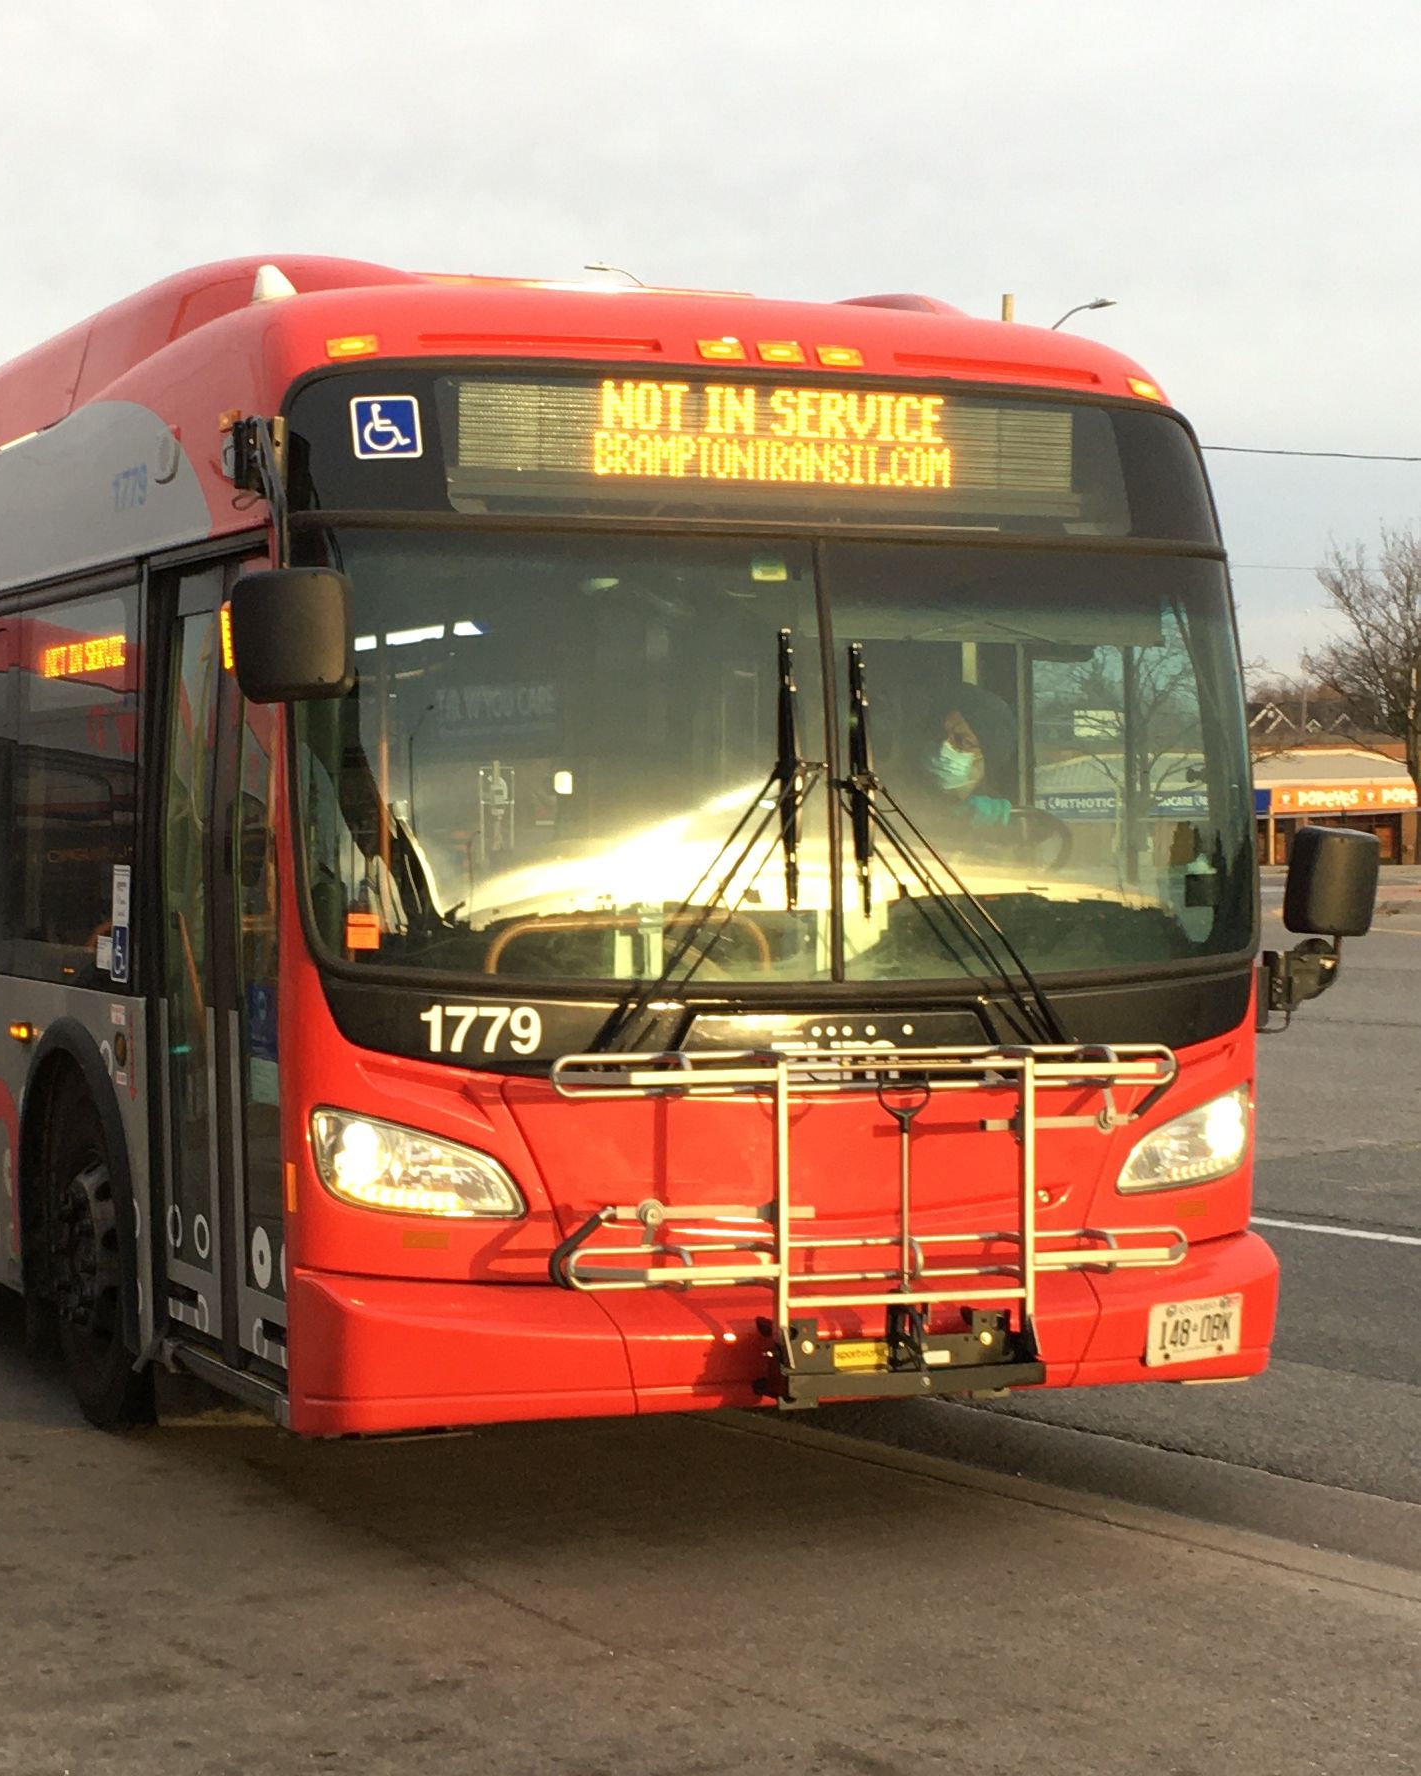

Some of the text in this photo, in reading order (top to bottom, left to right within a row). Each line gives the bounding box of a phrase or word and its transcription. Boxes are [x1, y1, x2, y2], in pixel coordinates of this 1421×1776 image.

[601, 380, 946, 444] NOT IN SERVICE
[593, 431, 952, 488] BRAMPTONTRANSIT.COM
[420, 1004, 542, 1055] 1779
